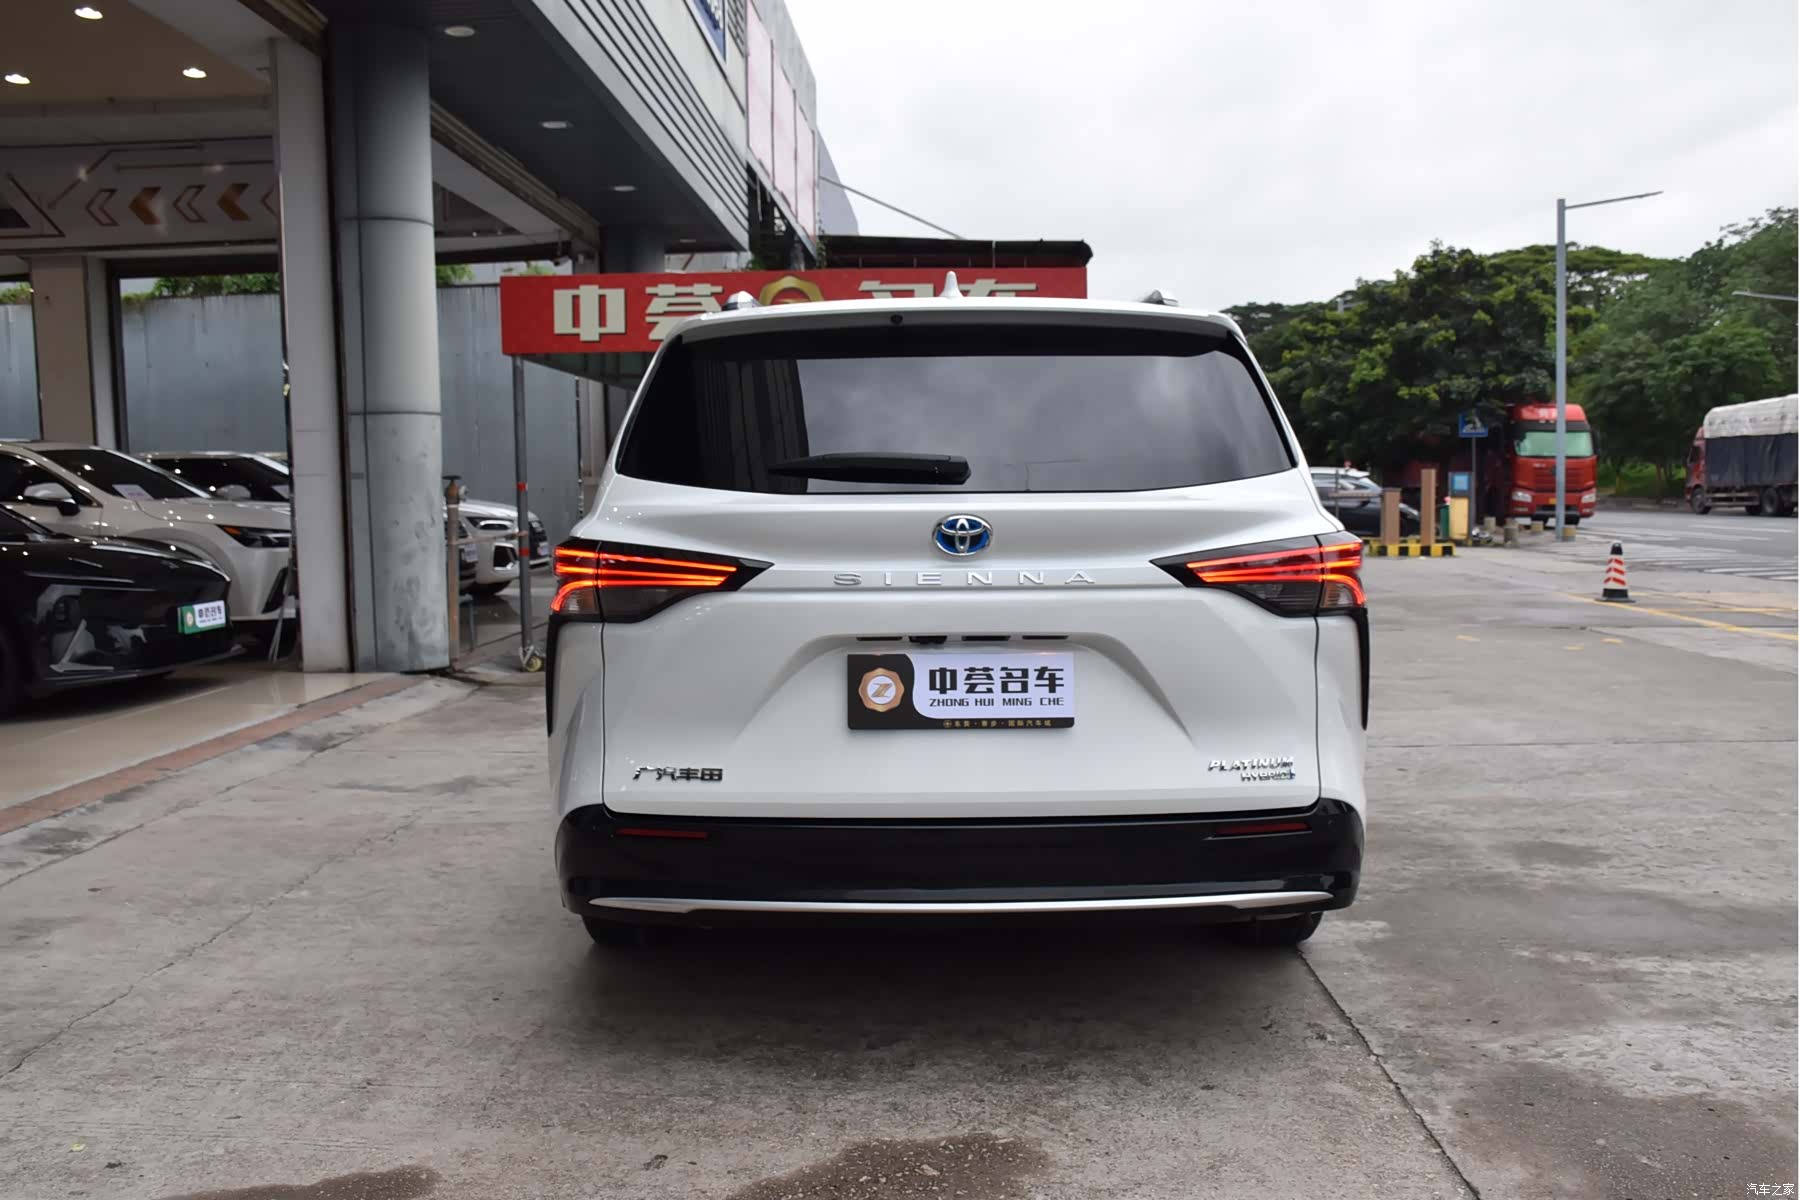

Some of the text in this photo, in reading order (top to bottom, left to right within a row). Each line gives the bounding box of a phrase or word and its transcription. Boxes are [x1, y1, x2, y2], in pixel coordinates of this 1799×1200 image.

[833, 570, 1096, 586] SIENNA
[929, 666, 1065, 695] 中荟名车
[929, 697, 1065, 707] ZHONG HUI MING CHE
[1208, 756, 1295, 772] PLATINUM
[632, 765, 724, 781] 广汽丰田
